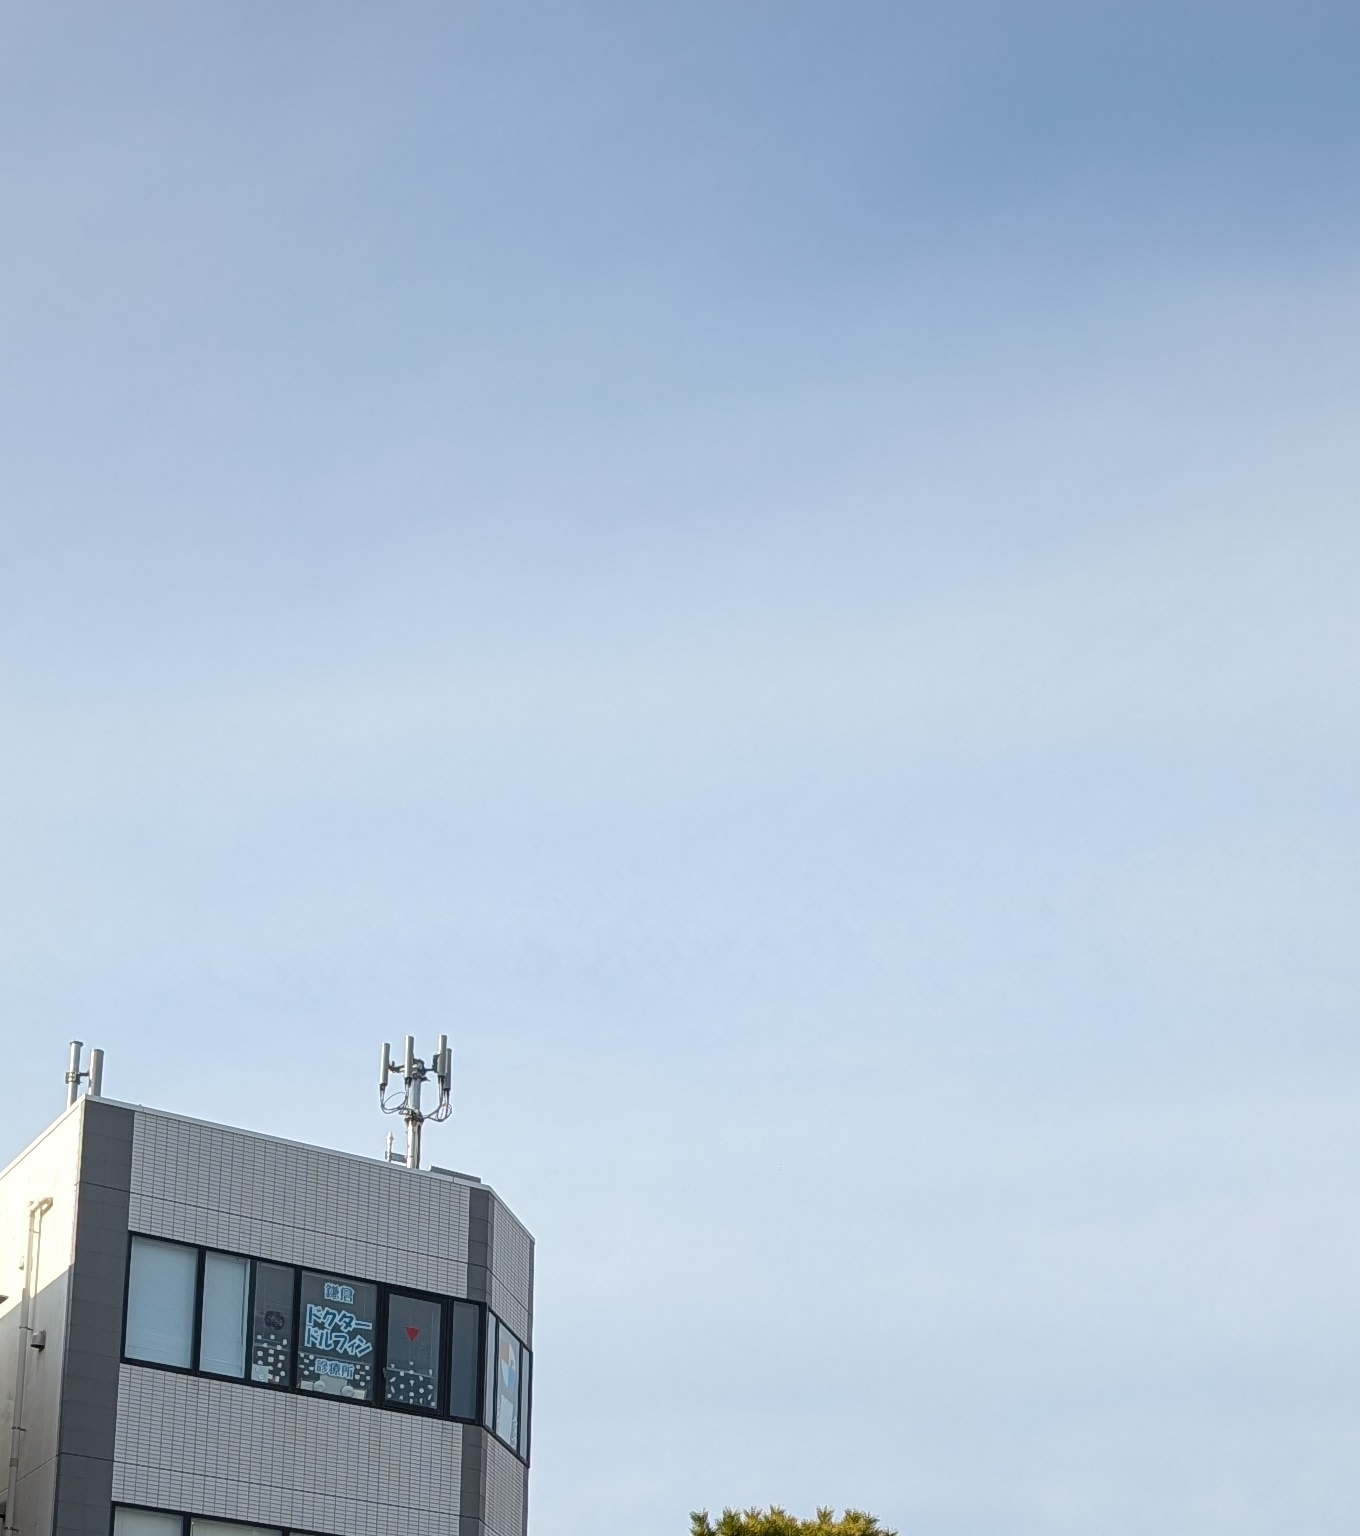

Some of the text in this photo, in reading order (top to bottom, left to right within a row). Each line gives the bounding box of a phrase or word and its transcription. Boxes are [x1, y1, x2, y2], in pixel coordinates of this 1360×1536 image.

[306, 1303, 373, 1332] ドクター
[304, 1327, 373, 1358] ドルフィン
